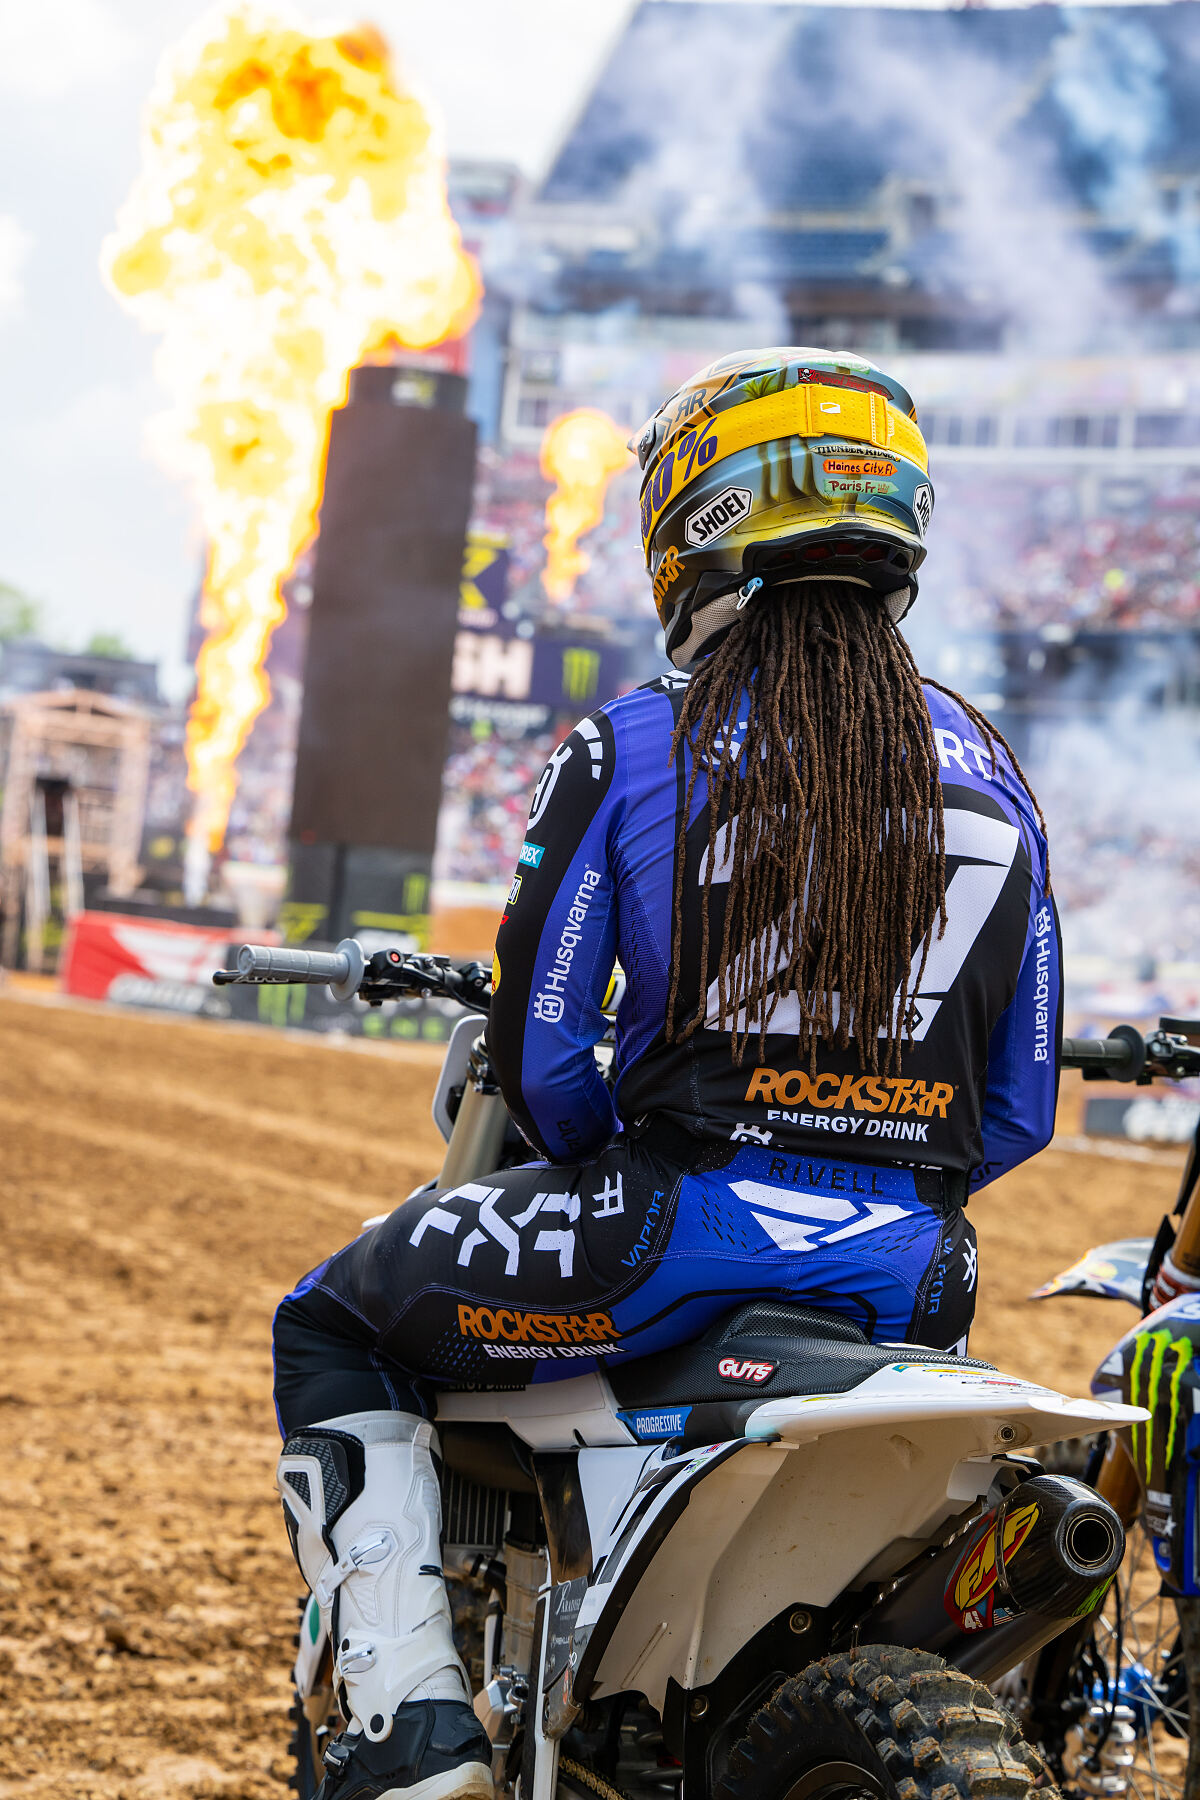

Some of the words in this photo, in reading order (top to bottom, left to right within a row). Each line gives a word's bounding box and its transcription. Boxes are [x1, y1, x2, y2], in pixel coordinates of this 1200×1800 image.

[828, 461, 860, 473] Haines
[691, 492, 746, 541] SHOEI
[545, 869, 602, 993] Husqvarna
[1034, 938, 1051, 1062] Husqvarna
[744, 1067, 954, 1119] ROCKSTAR
[767, 1109, 865, 1135] ENERGY
[864, 1119, 930, 1143] DRINK
[768, 1156, 884, 1195] RIVELL
[620, 1189, 665, 1268] VAPOR
[457, 1303, 623, 1343] ROCKSTAR
[482, 1343, 555, 1360] ENERGY
[556, 1342, 625, 1359] DRINK
[718, 1357, 774, 1382] GUTS
[636, 1413, 683, 1434] PROGRESSIVE
